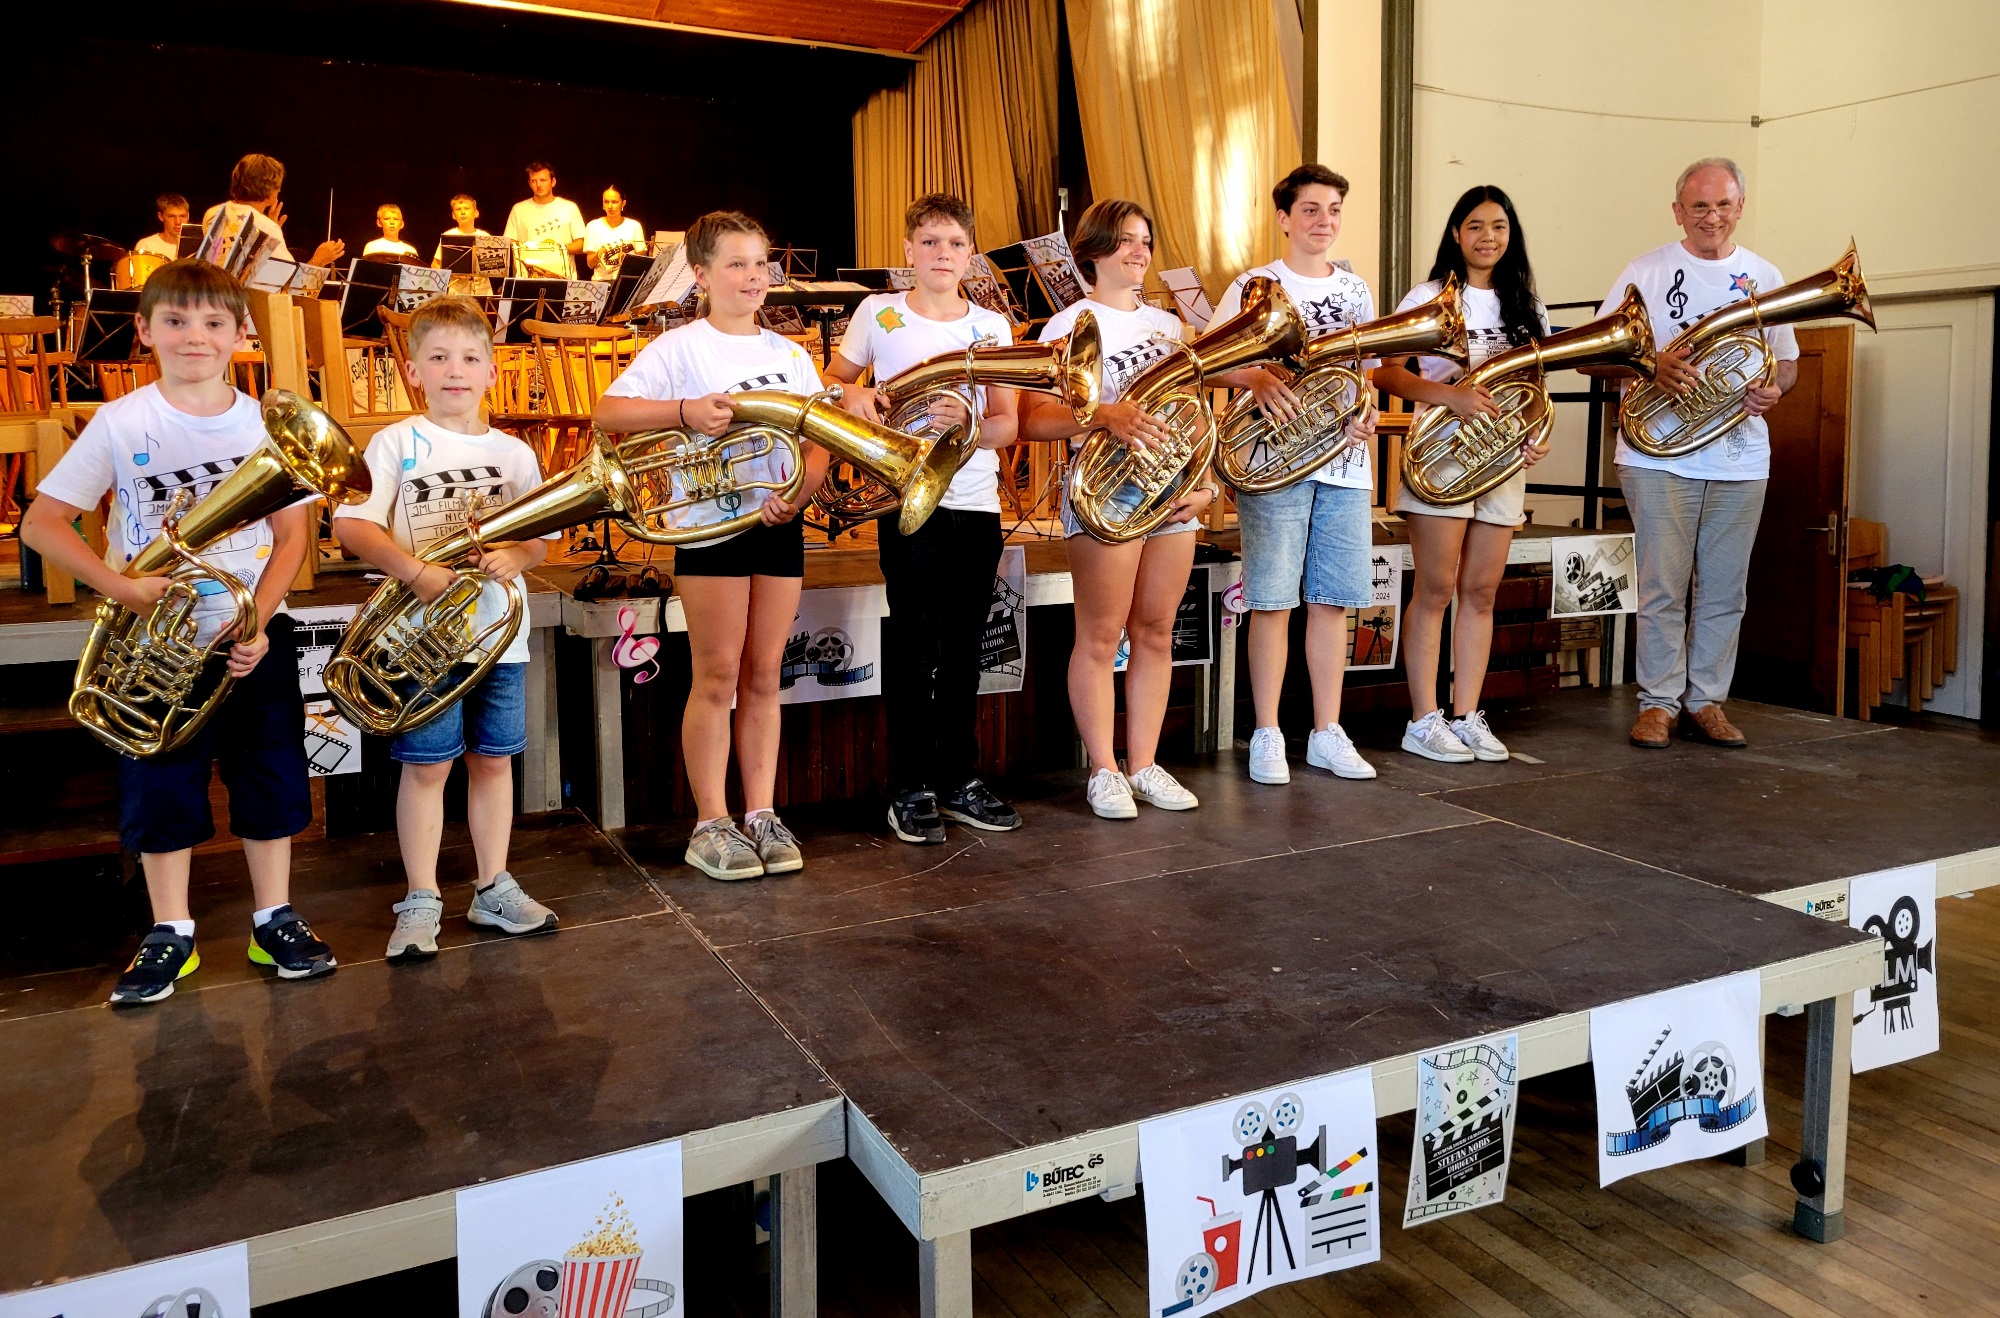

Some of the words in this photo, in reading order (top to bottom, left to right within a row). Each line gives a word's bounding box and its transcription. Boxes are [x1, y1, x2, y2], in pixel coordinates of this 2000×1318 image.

[412, 505, 433, 516] JML
[1375, 592, 1391, 601] 2024
[981, 637, 1005, 650] TUDIOS
[1437, 1148, 1467, 1169] STEFAN
[1468, 1136, 1491, 1153] NOBIS
[1447, 1153, 1479, 1174] DIRIGENT
